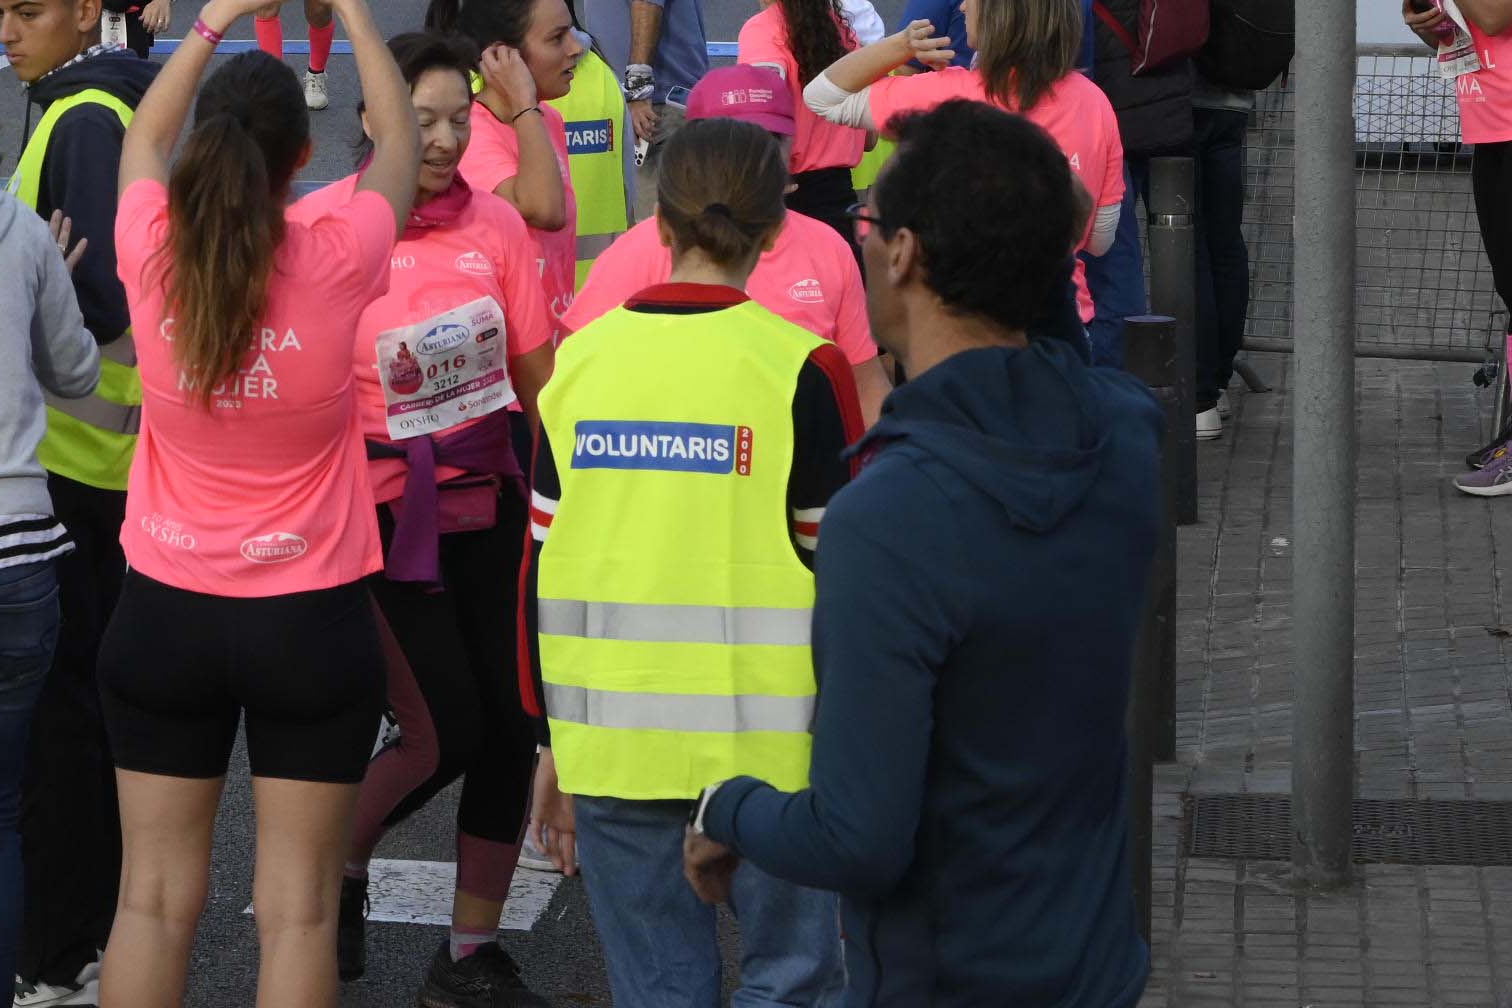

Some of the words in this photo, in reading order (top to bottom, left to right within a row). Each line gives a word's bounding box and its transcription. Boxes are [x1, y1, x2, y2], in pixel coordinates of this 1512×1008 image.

[471, 313, 494, 327] SUMA
[421, 331, 467, 353] ASTURIANA
[426, 354, 467, 380] 016
[433, 374, 460, 391] 3212
[446, 390, 457, 399] LA
[456, 382, 481, 395] MUJER
[399, 413, 440, 430] OYSHO
[574, 433, 731, 462] VOLUNTARIS
[740, 427, 750, 475] 2000
[246, 541, 305, 558] ASTURIANA
